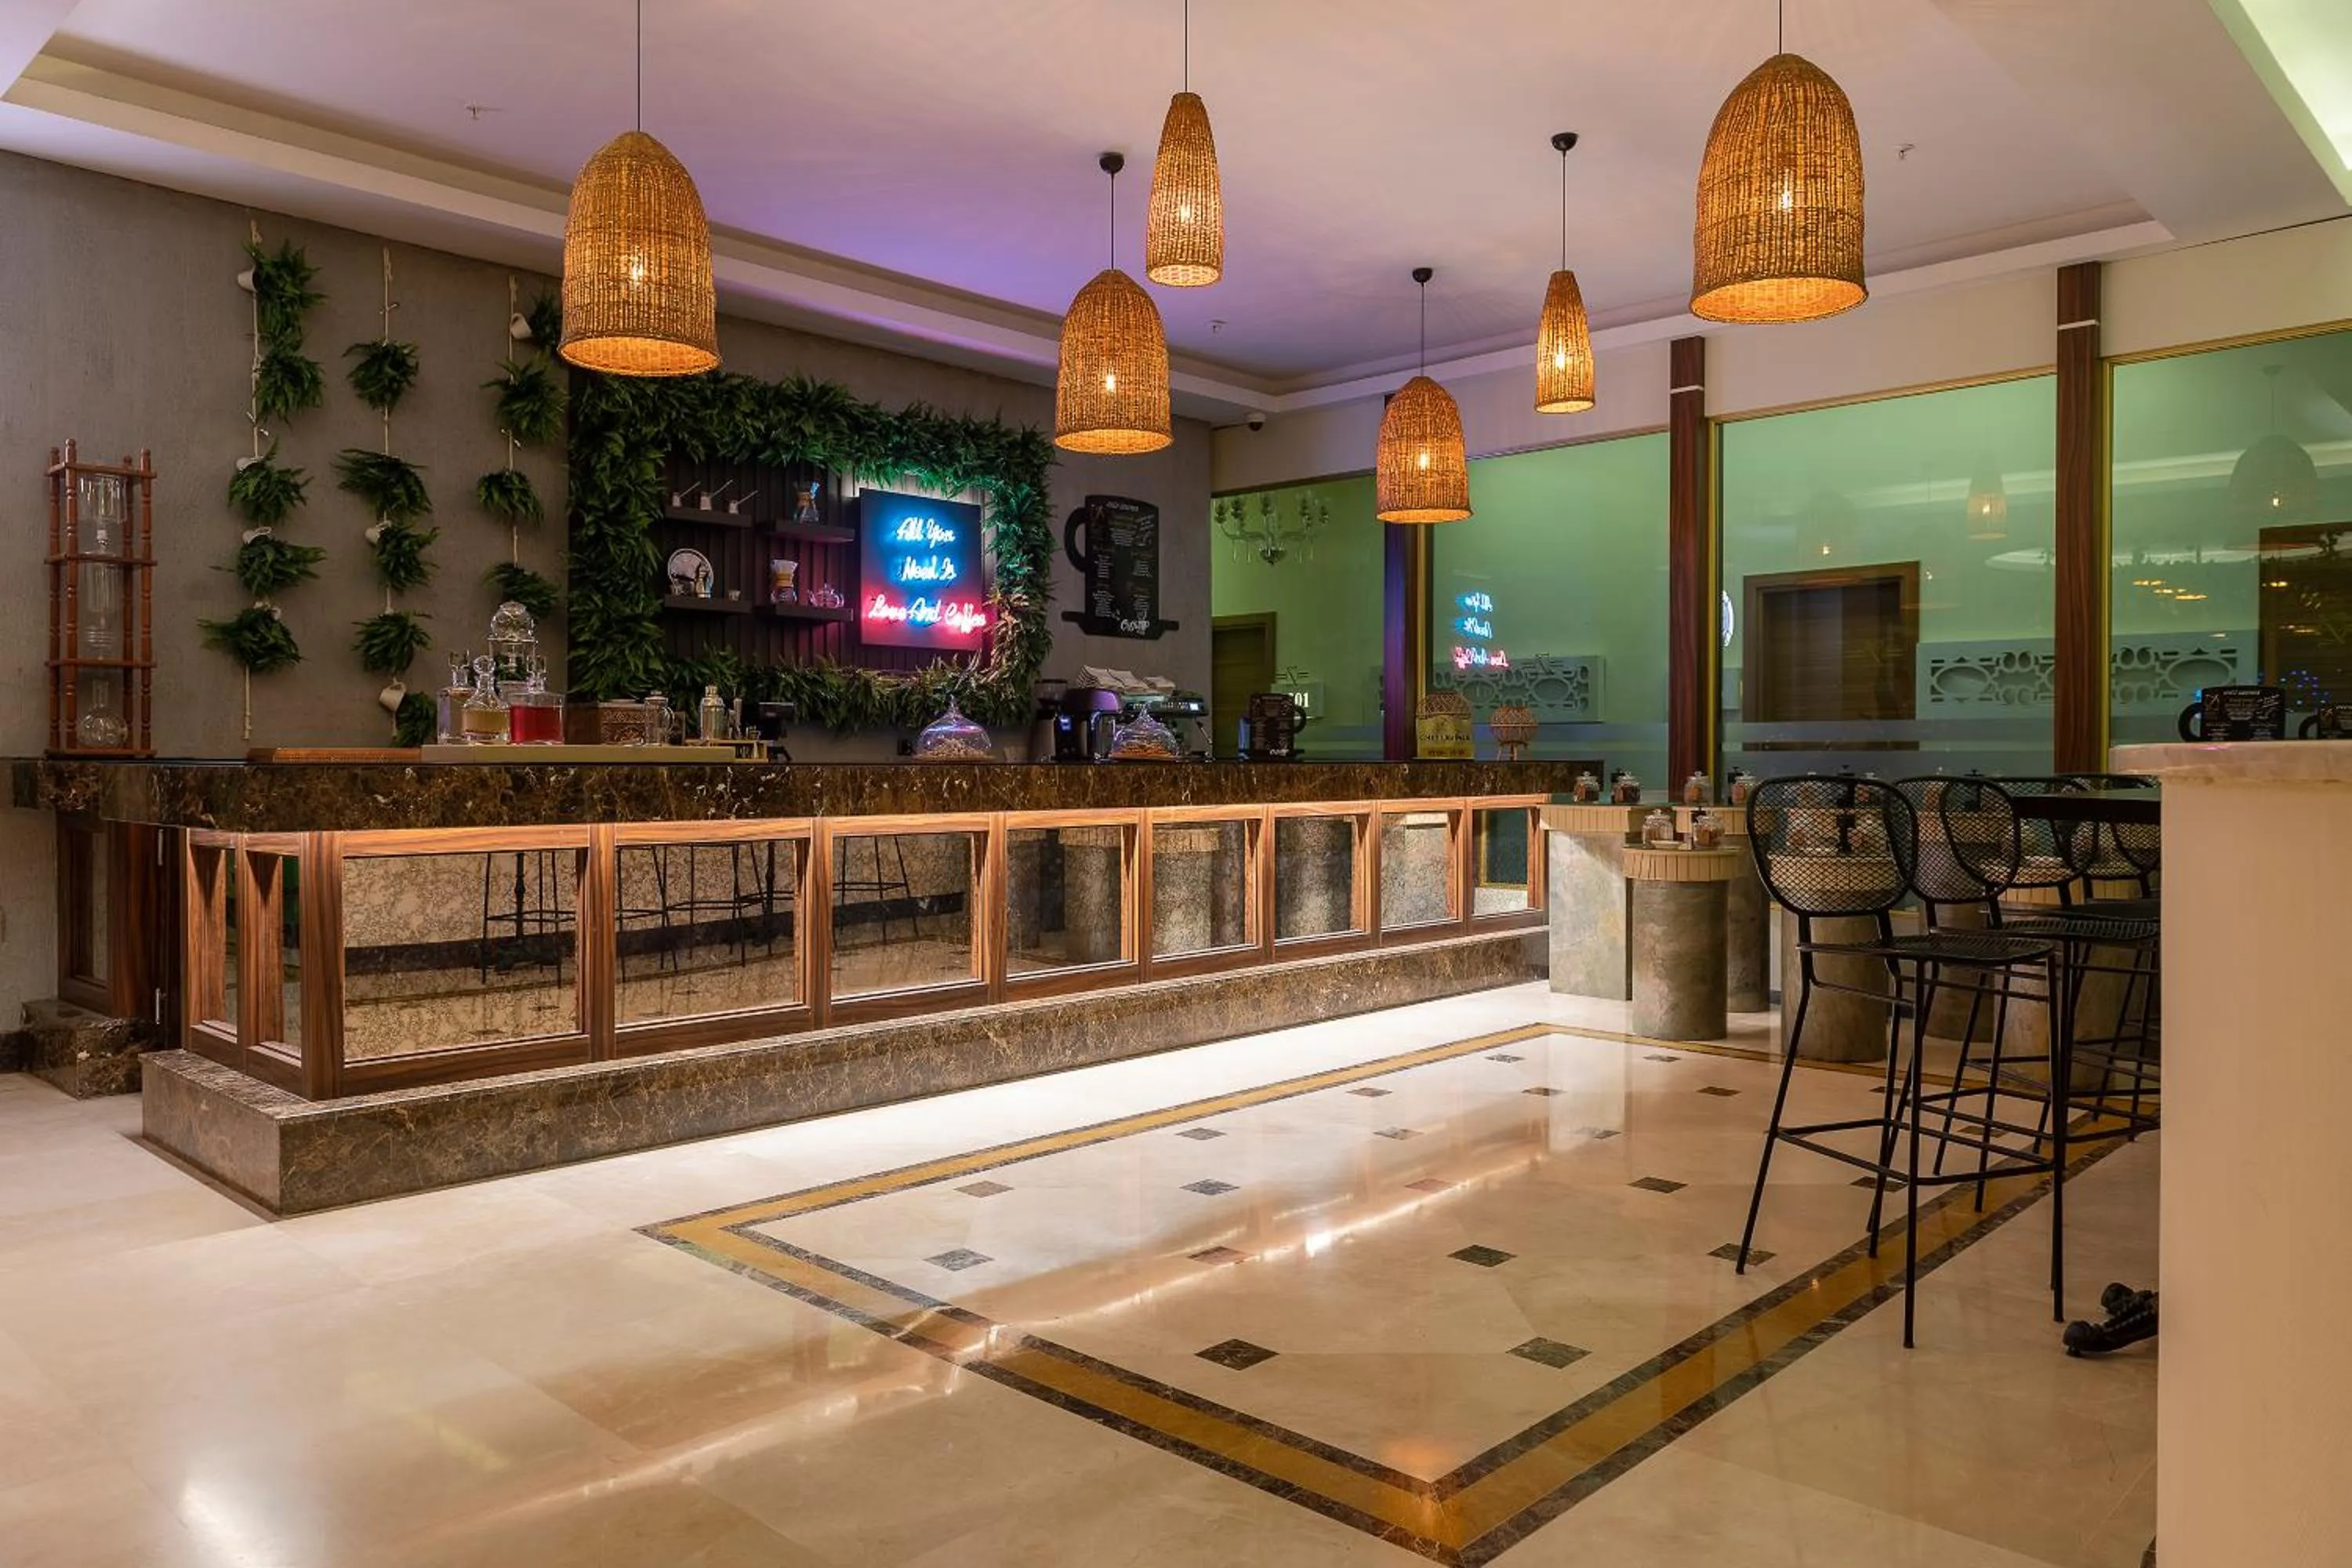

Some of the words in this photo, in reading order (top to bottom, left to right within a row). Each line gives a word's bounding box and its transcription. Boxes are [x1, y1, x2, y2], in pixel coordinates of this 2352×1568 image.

[896, 517, 924, 542] All
[927, 518, 956, 549] You
[901, 555, 938, 581] Need
[938, 557, 957, 580] Is
[868, 593, 906, 622] Love
[907, 597, 942, 622] And
[945, 602, 987, 633] Coffee
